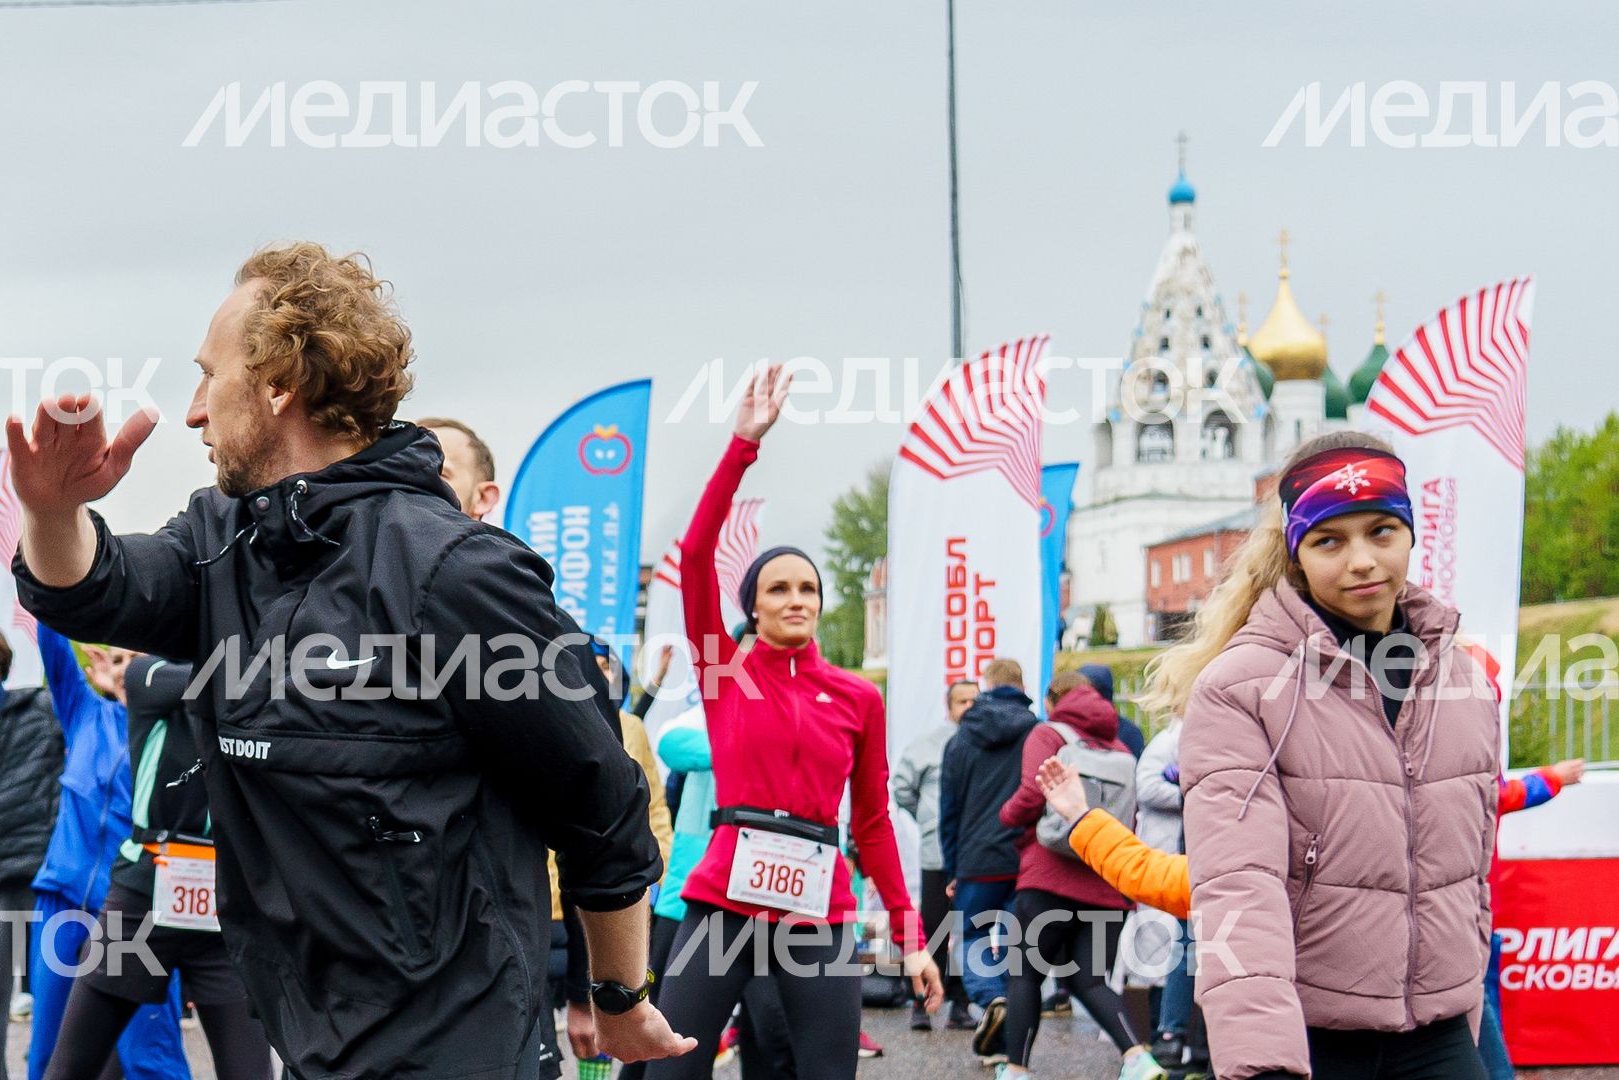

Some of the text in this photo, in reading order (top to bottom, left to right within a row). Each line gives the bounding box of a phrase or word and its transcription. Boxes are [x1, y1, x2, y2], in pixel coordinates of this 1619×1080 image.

[1438, 476, 1458, 609] МОСКОВЬЯ
[235, 738, 255, 758] DO
[255, 741, 271, 760] IT
[749, 860, 806, 897] 3186
[172, 885, 218, 917] 318
[1499, 963, 1619, 991] СКОВЬ
